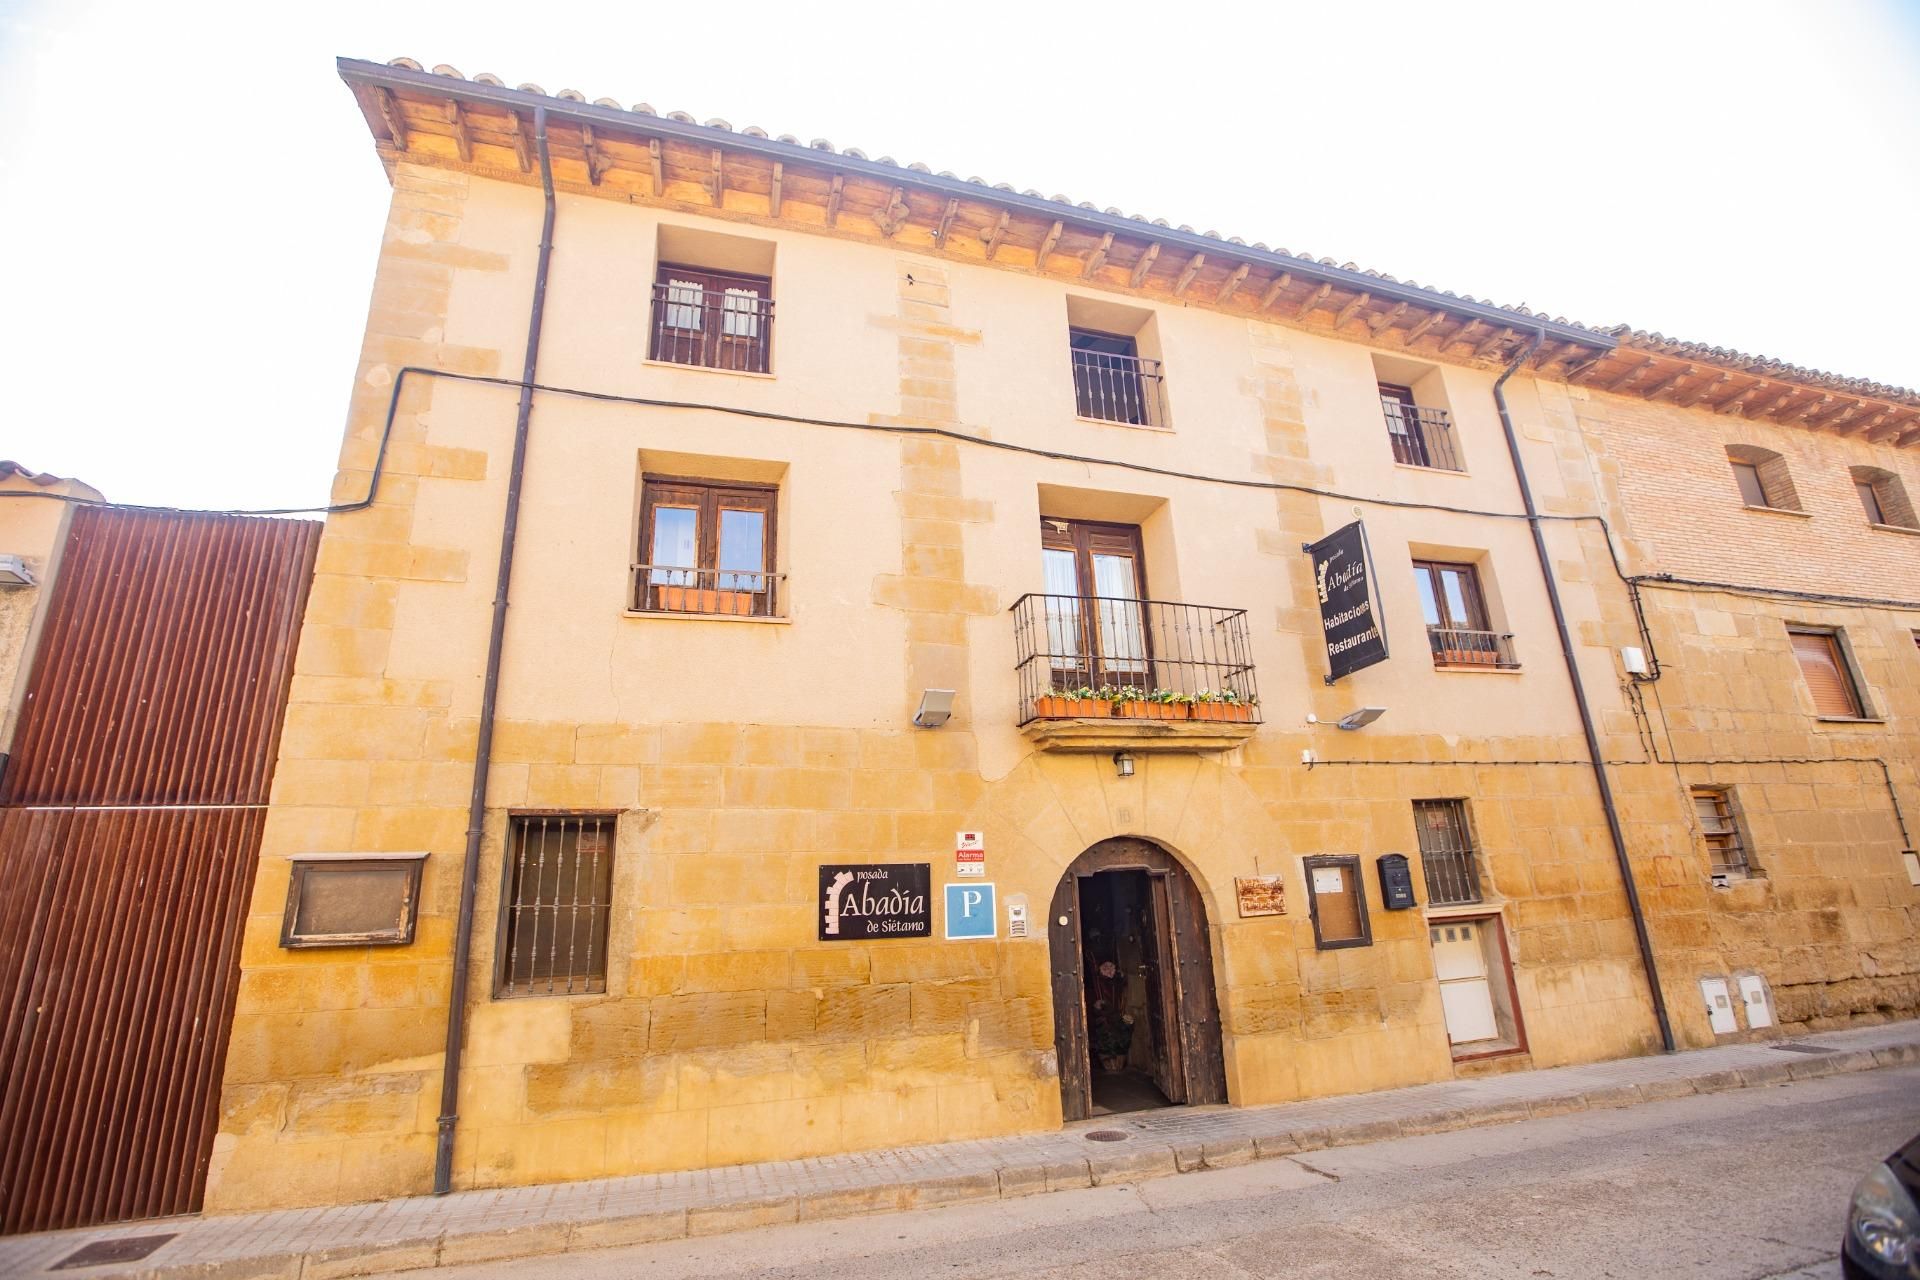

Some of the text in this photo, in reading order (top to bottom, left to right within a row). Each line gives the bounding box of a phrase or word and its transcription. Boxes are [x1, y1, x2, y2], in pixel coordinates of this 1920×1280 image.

[857, 868, 889, 883] posada
[840, 880, 924, 917] Abadía
[962, 890, 982, 918] P
[867, 918, 924, 933] de Siétamo
